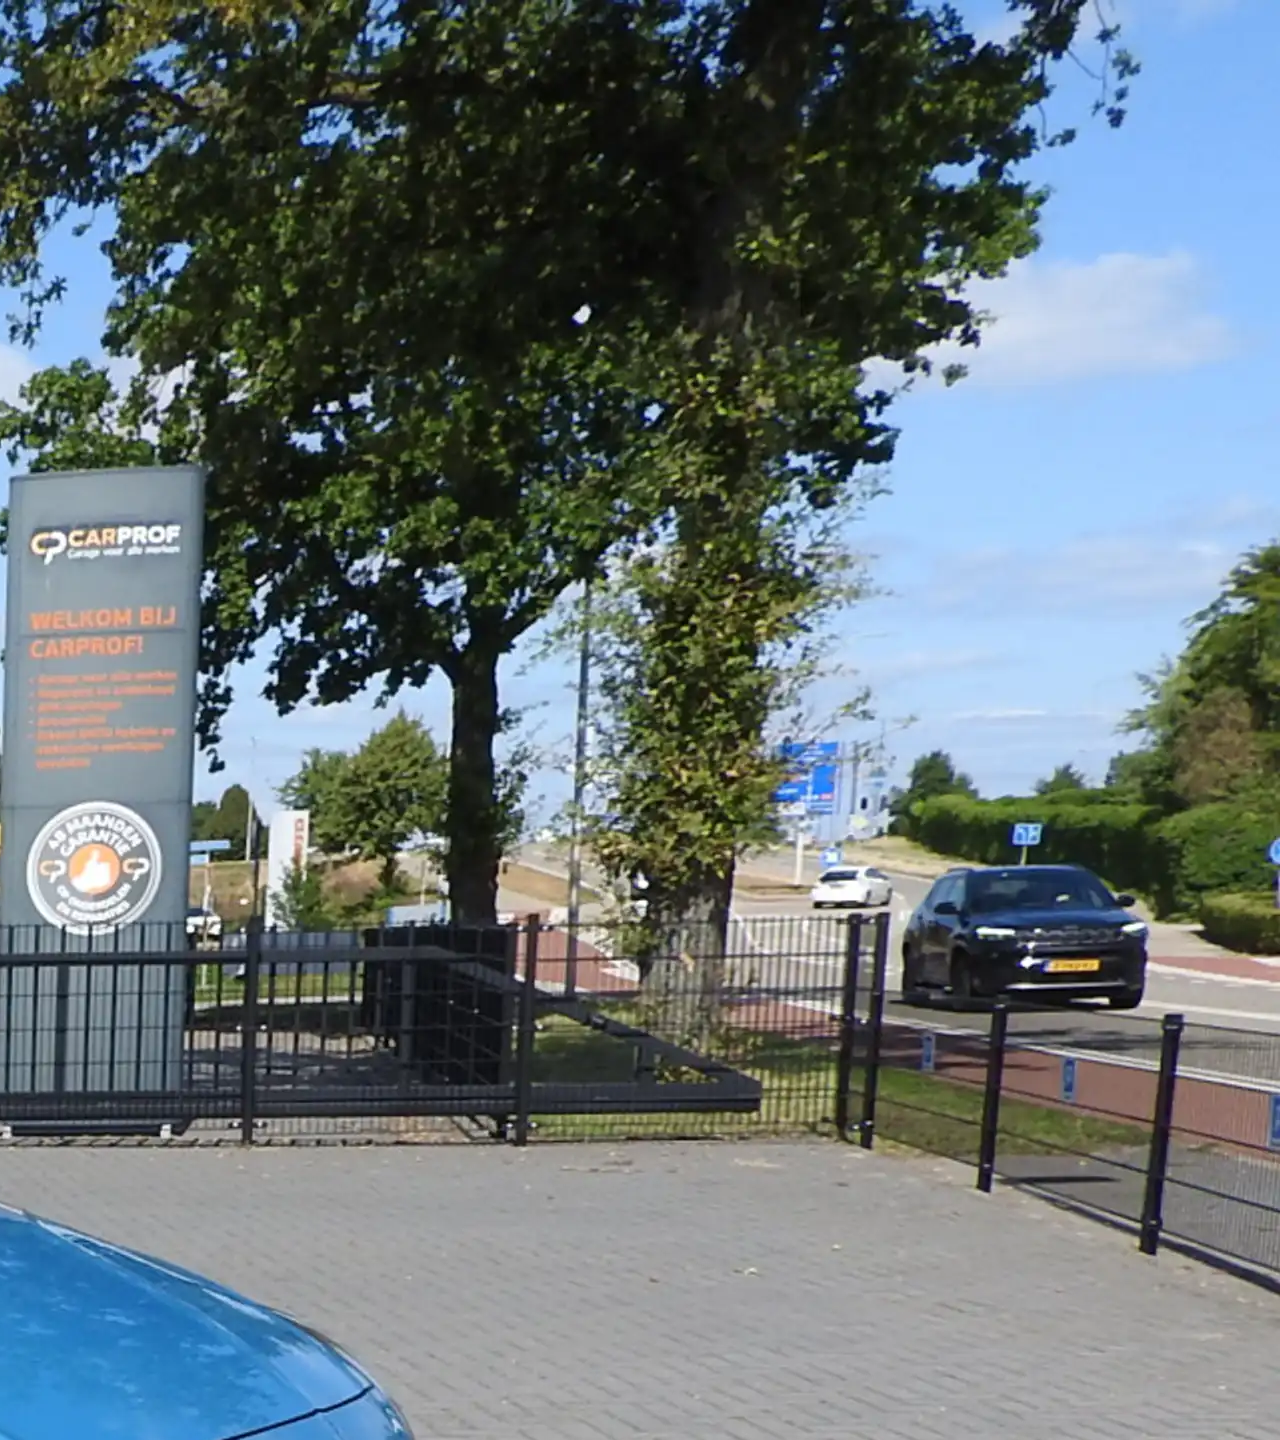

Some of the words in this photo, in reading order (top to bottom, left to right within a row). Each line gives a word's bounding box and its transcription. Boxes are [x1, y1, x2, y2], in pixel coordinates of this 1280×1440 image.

[67, 524, 181, 547] CARPROF
[30, 607, 132, 630] WELKOM
[140, 605, 176, 625] BIJ
[29, 635, 144, 658] CARPROF!
[60, 829, 132, 857] GARANTIE
